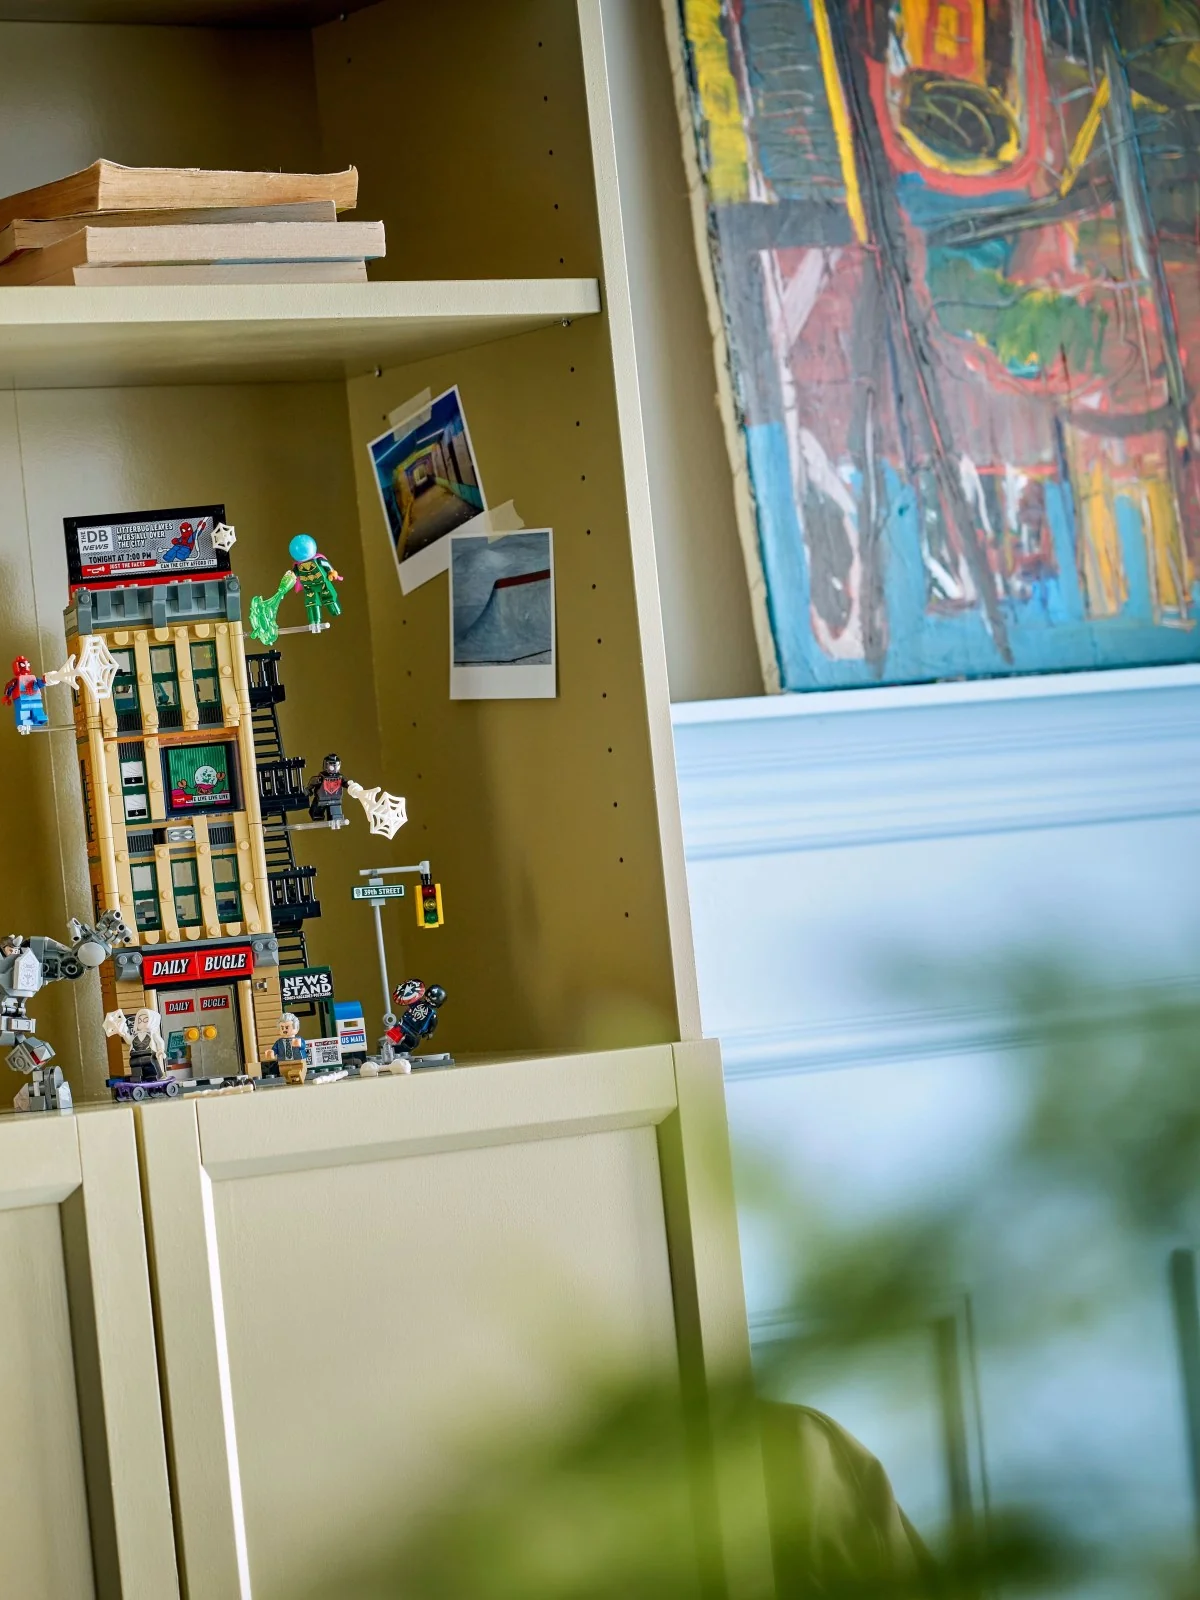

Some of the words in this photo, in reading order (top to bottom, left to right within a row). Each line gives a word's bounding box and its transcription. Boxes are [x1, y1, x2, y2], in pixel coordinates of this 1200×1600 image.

[116, 525, 149, 534] LITTERBUG
[151, 522, 173, 530] LEAVES
[86, 530, 108, 543] DB
[117, 533, 134, 541] WEBS
[136, 532, 146, 540] ALL
[150, 530, 165, 538] OVER
[82, 543, 109, 551] NEWS
[131, 539, 145, 547] CITY
[88, 555, 116, 564] TONIGHT
[378, 887, 401, 895] STREET
[152, 959, 189, 976] DAILY
[204, 953, 246, 971] BUGLE
[284, 974, 328, 988] NEWS
[282, 984, 332, 997] STAND
[169, 1001, 190, 1012] DAILY
[202, 998, 227, 1008] BUGLE
[350, 1035, 364, 1043] MAIL
